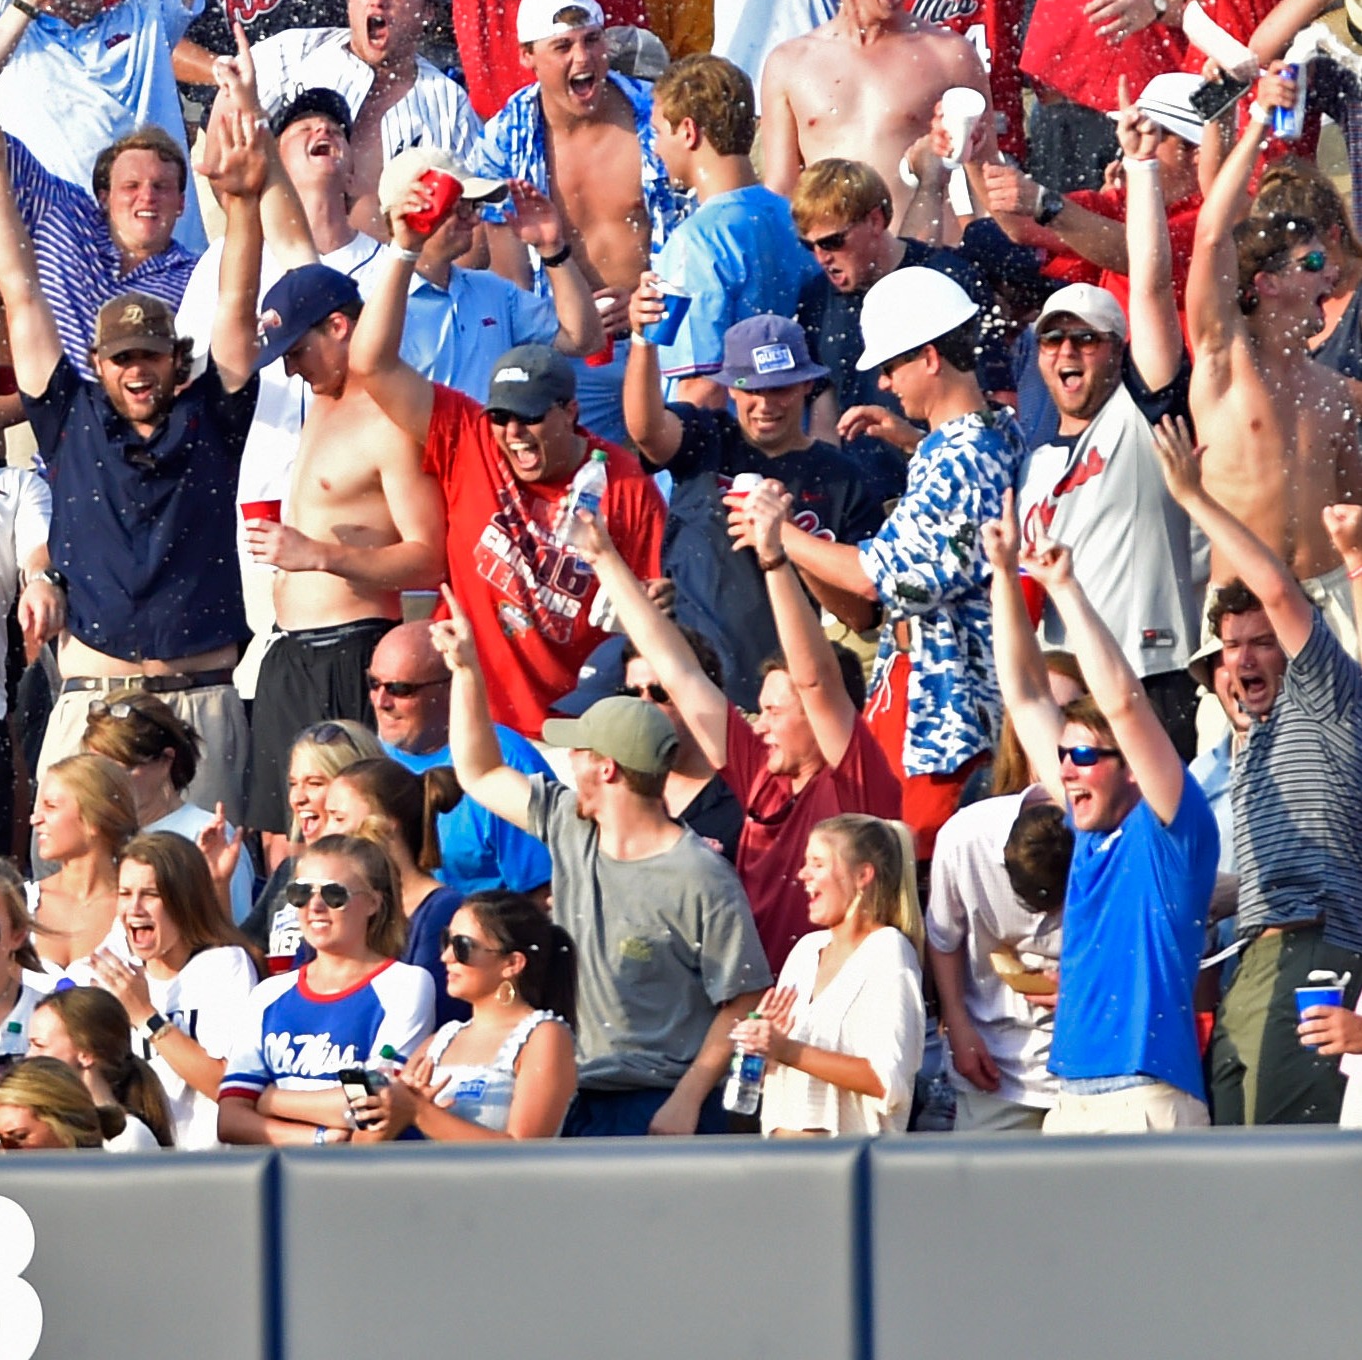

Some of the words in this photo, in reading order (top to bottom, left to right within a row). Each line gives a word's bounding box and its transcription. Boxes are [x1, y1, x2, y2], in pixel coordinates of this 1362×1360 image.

[757, 349, 788, 365] GUEST
[264, 1031, 296, 1074] Ole
[293, 1031, 364, 1077] Miss
